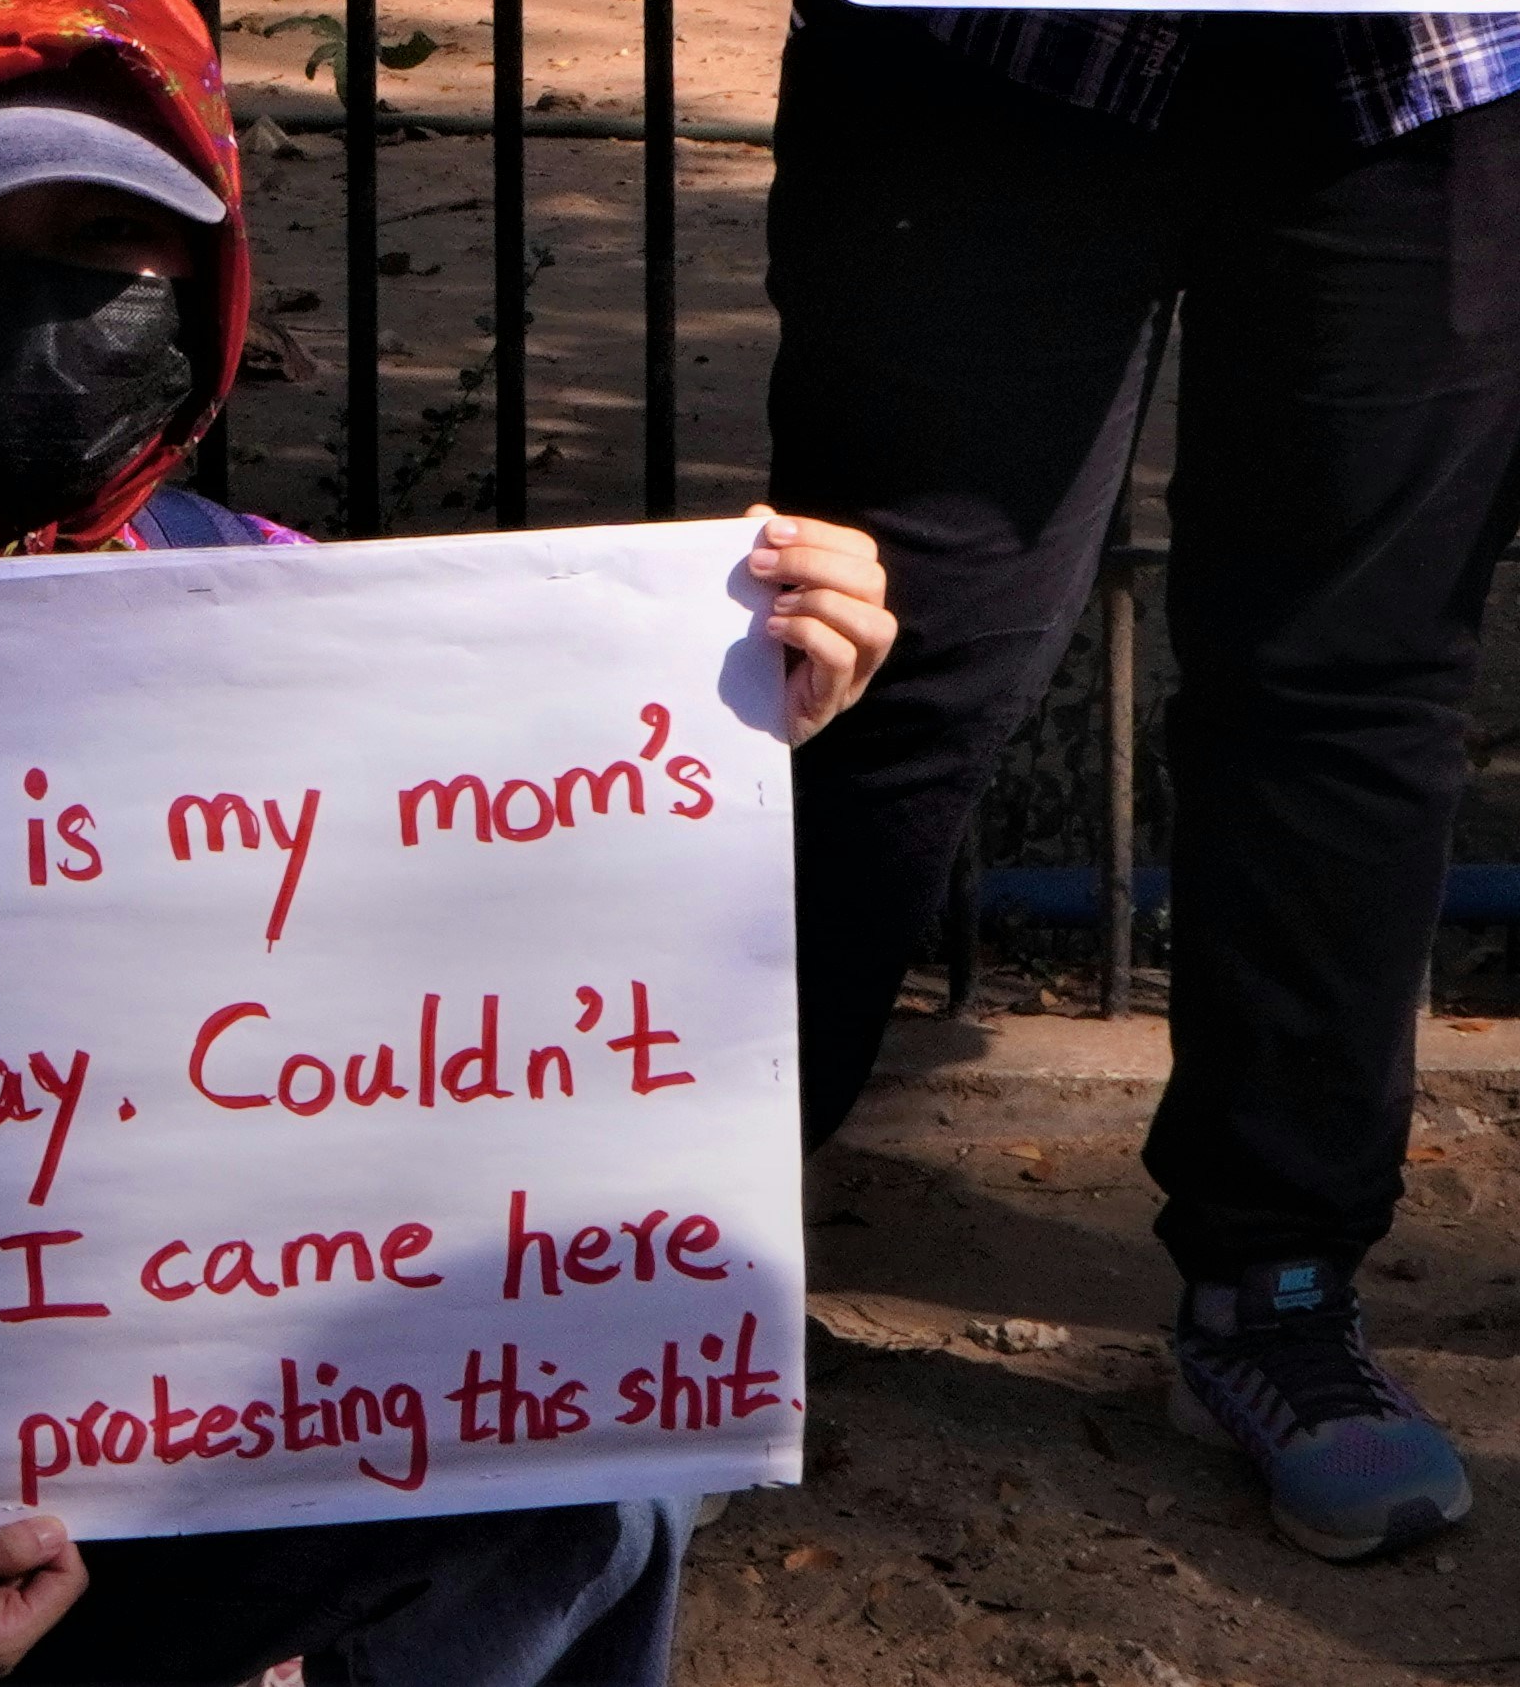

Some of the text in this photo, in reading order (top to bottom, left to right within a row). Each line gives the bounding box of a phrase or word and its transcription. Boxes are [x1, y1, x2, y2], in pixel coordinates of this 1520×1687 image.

[21, 766, 105, 888] is
[165, 789, 323, 953] my
[396, 701, 717, 849] mom's
[186, 979, 698, 1119] Couldn't
[138, 1220, 444, 1304] came
[16, 1358, 429, 1509] protesting
[448, 1342, 591, 1444] this
[614, 1313, 805, 1431] shit.
